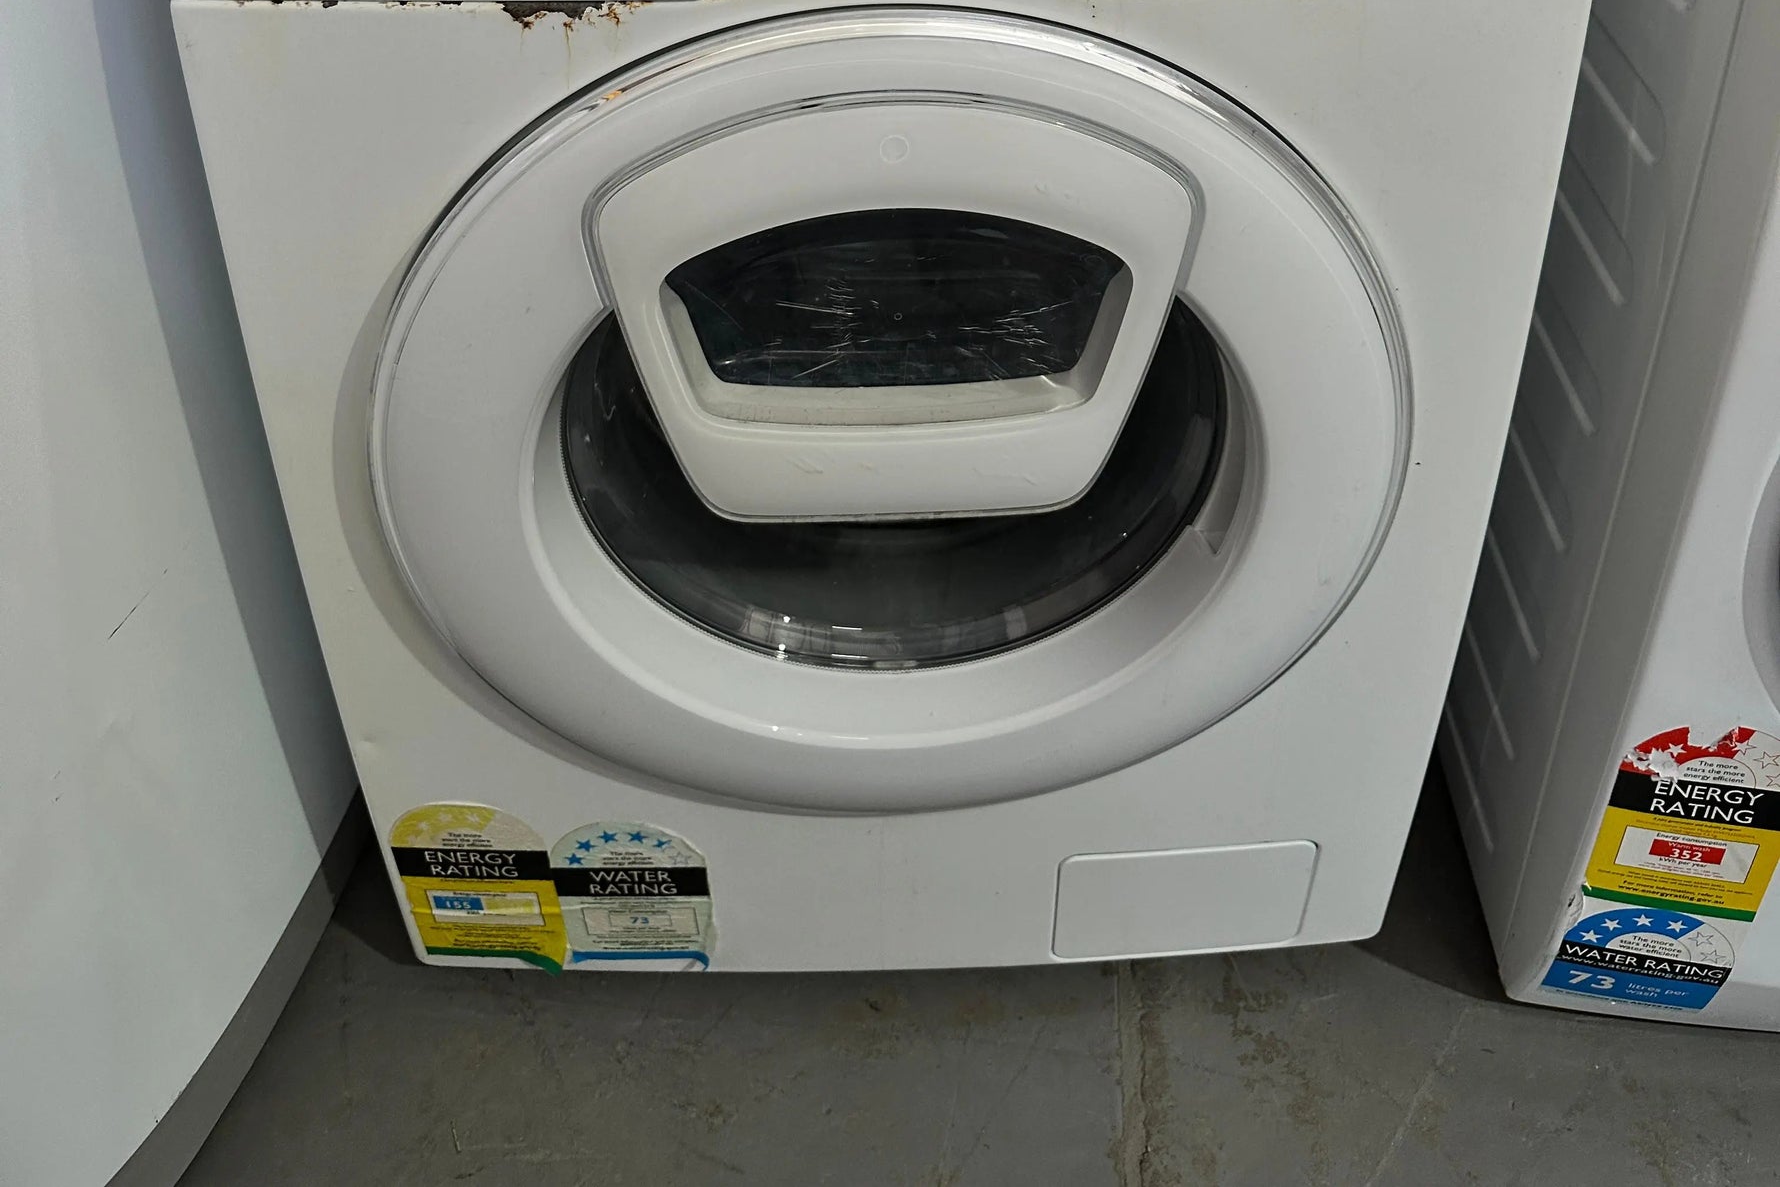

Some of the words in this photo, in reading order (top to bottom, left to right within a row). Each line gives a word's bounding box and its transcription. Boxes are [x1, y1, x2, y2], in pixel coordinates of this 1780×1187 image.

[1683, 772, 1711, 781] energy
[1712, 776, 1745, 784] efficient
[1723, 770, 1746, 778] more
[1654, 779, 1765, 806] ENERGY
[1650, 798, 1755, 824] RATING
[1656, 832, 1681, 840] Energy
[424, 851, 516, 864] ENERGY
[1669, 848, 1703, 862] 352
[1678, 860, 1692, 868] per
[430, 865, 519, 877] RATING
[590, 871, 671, 882] WATER
[589, 884, 678, 894] RATING
[1619, 944, 1645, 952] water
[1645, 948, 1679, 958] efficient
[1658, 946, 1682, 954] more
[1566, 944, 1637, 965] WATER
[1644, 959, 1723, 979] RATING
[1568, 970, 1616, 990] 73
[1625, 988, 1658, 998] wash
[1628, 982, 1661, 993] litres
